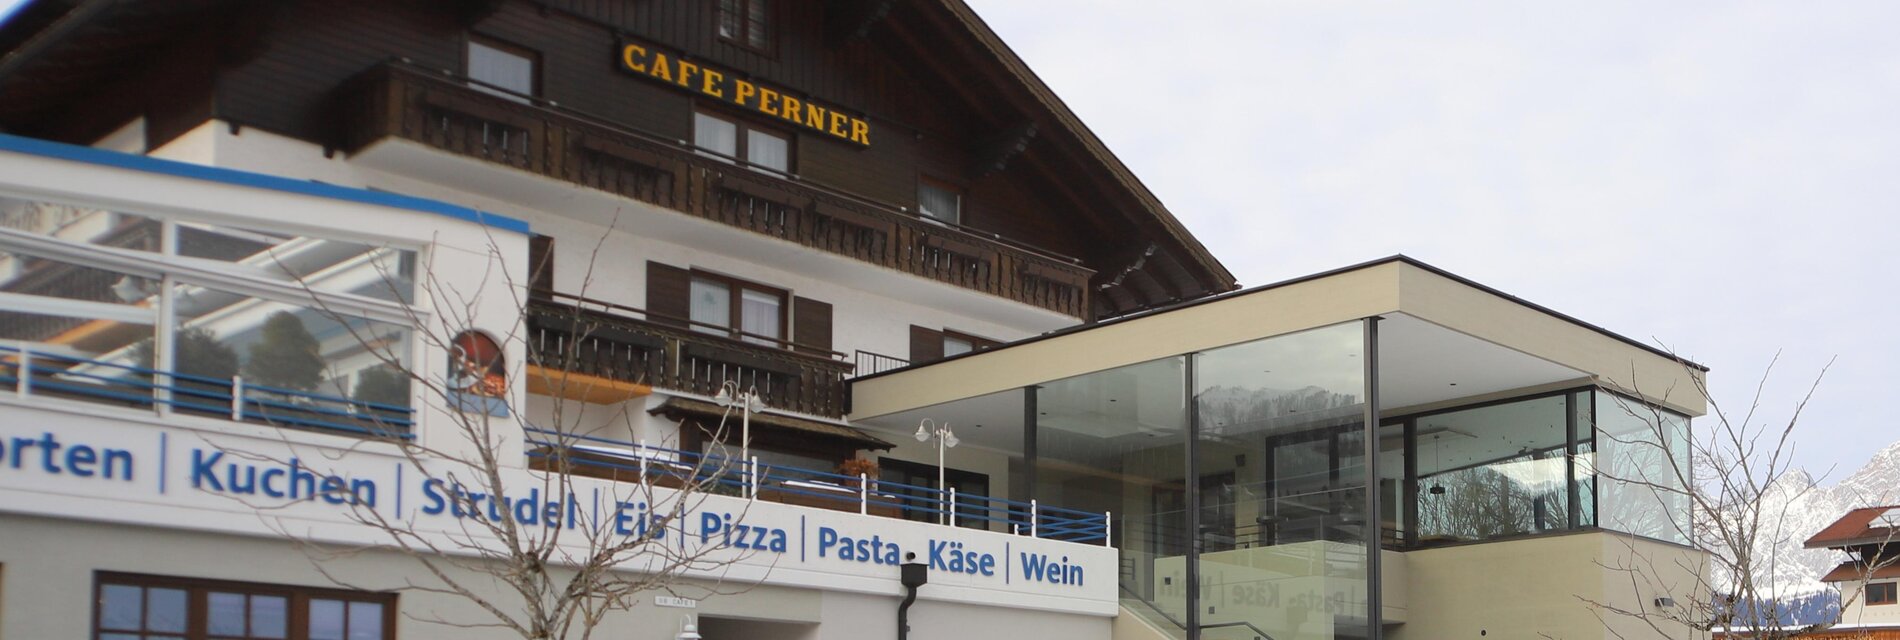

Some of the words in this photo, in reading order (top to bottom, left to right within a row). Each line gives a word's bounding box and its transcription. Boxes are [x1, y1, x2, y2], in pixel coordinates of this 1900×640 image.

[623, 44, 723, 98] CAFE
[735, 79, 871, 146] PERNER
[0, 431, 134, 481] rten
[191, 448, 377, 507] Kuchen
[422, 478, 575, 529] Strudel
[616, 501, 666, 539] Eis
[701, 512, 787, 552] Pizza
[818, 527, 901, 567] Pasta
[928, 540, 995, 576] Käse
[1020, 552, 1085, 586] Wein
